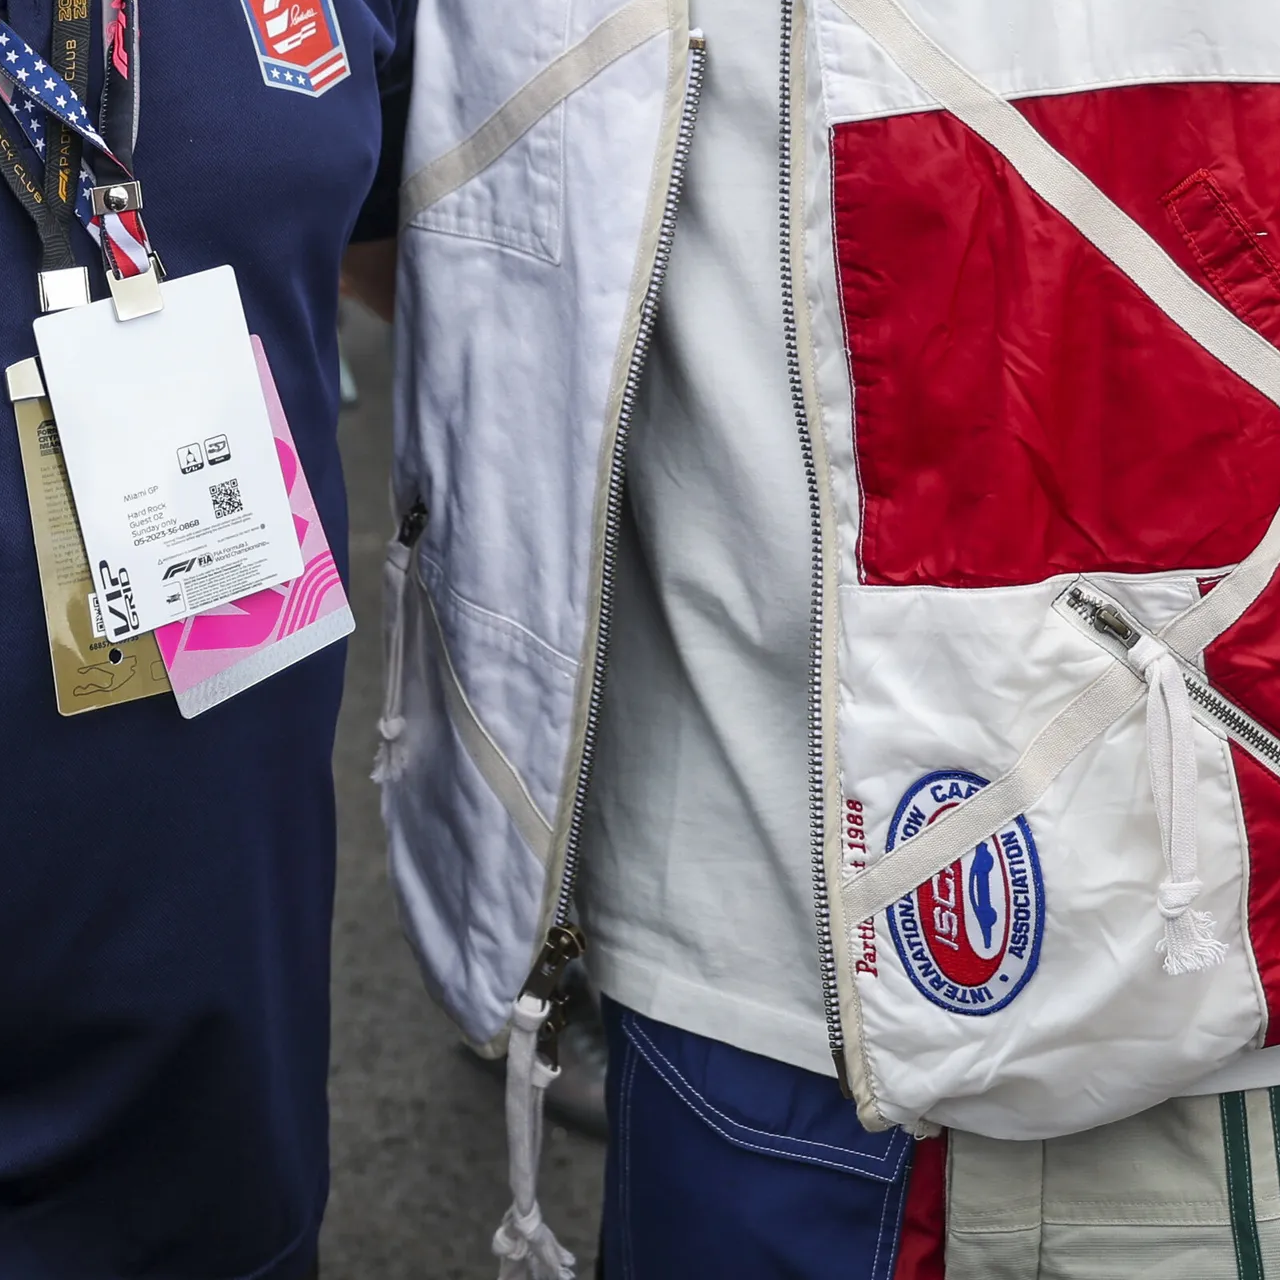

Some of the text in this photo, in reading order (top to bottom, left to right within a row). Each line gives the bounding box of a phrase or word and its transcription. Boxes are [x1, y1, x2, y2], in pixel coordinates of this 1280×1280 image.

[64, 38, 77, 81] CLUB
[12, 163, 43, 205] CLUB
[123, 485, 159, 503] Miami GP
[127, 502, 167, 521] Hard Rock
[129, 512, 165, 529] Guest 02
[131, 522, 161, 539] Sunday
[161, 517, 178, 531] only
[198, 554, 214, 567] FIA
[99, 559, 131, 637] VIP
[119, 566, 140, 631] GRID
[846, 799, 867, 854] 1988
[931, 866, 959, 952] ISC
[1000, 830, 1032, 960] ASSOCIATION
[898, 890, 994, 1005] INTERNATIONA
